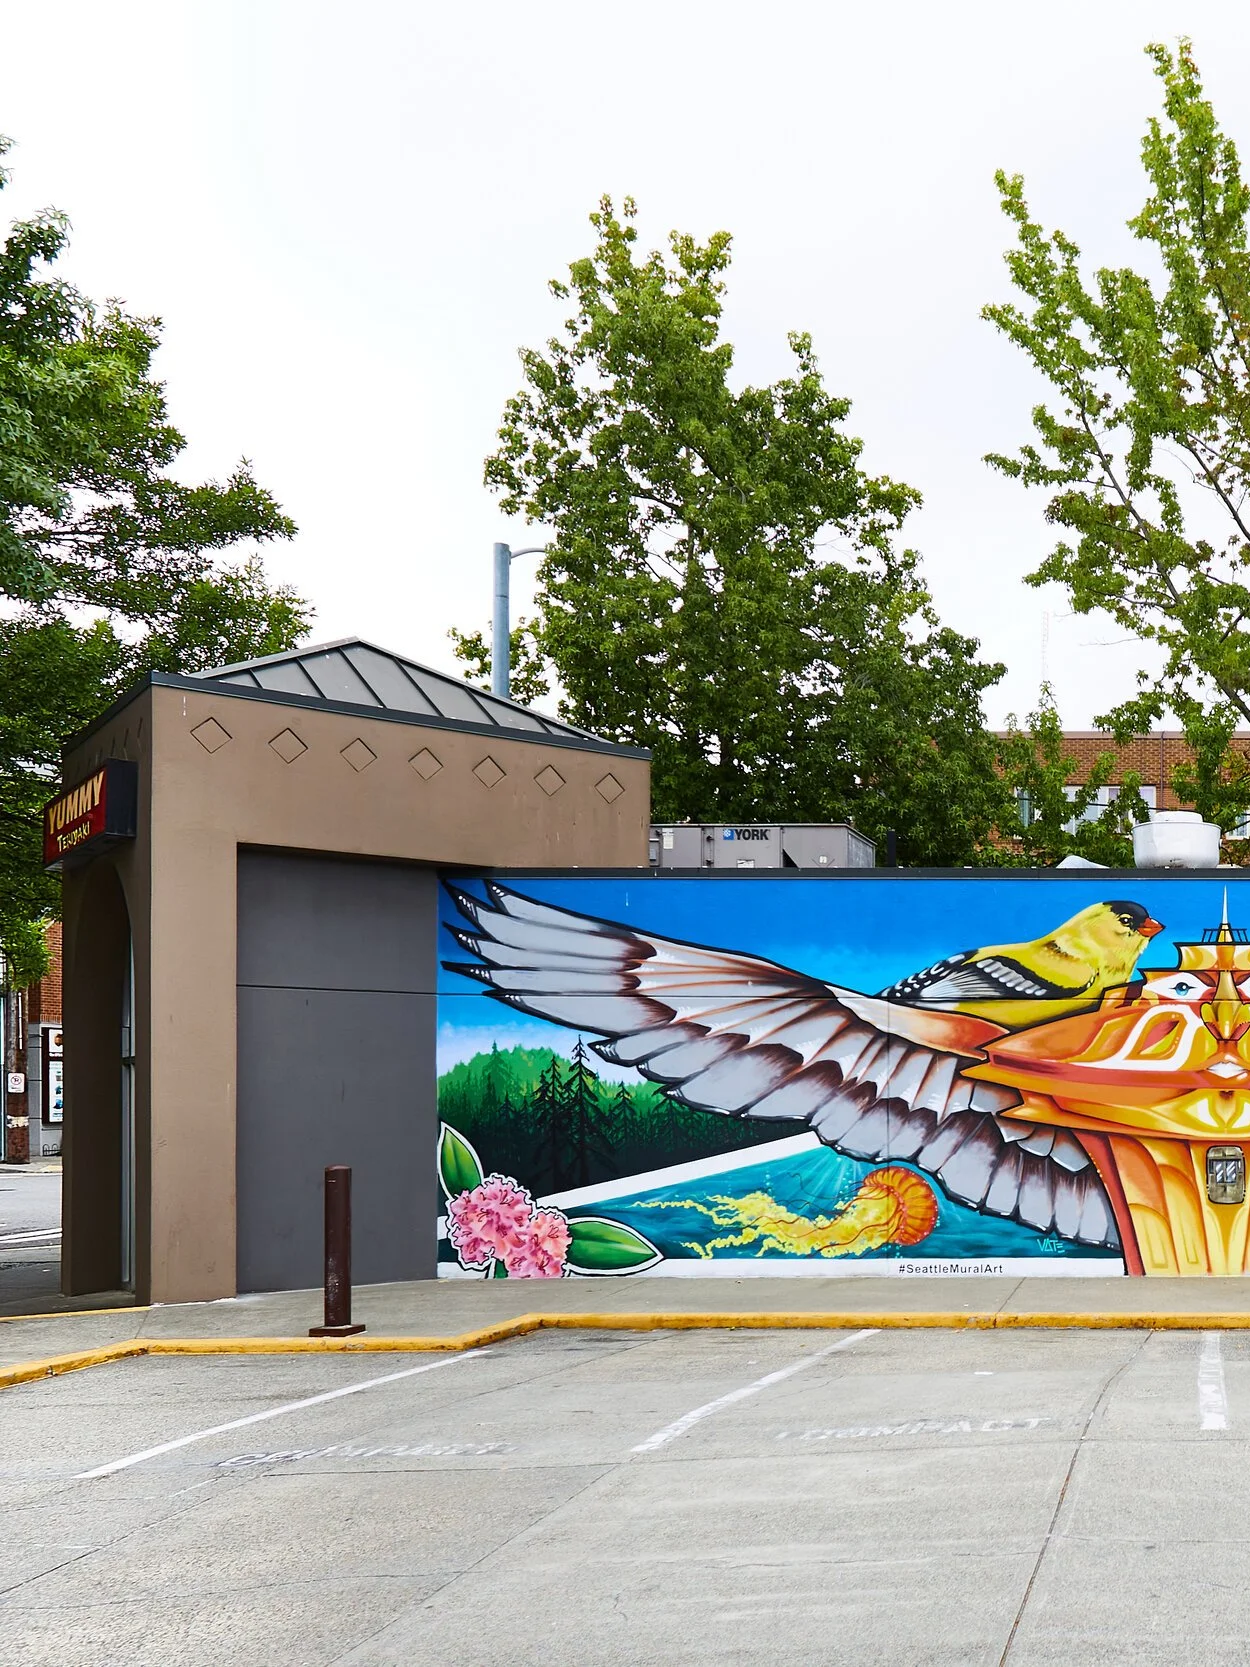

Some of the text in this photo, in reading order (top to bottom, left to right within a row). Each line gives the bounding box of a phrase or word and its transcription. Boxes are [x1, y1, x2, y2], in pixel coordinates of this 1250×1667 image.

[49, 771, 105, 835] YUMMY
[735, 829, 769, 841] YORK
[899, 1264, 1003, 1275] #SeattleMuralArt
